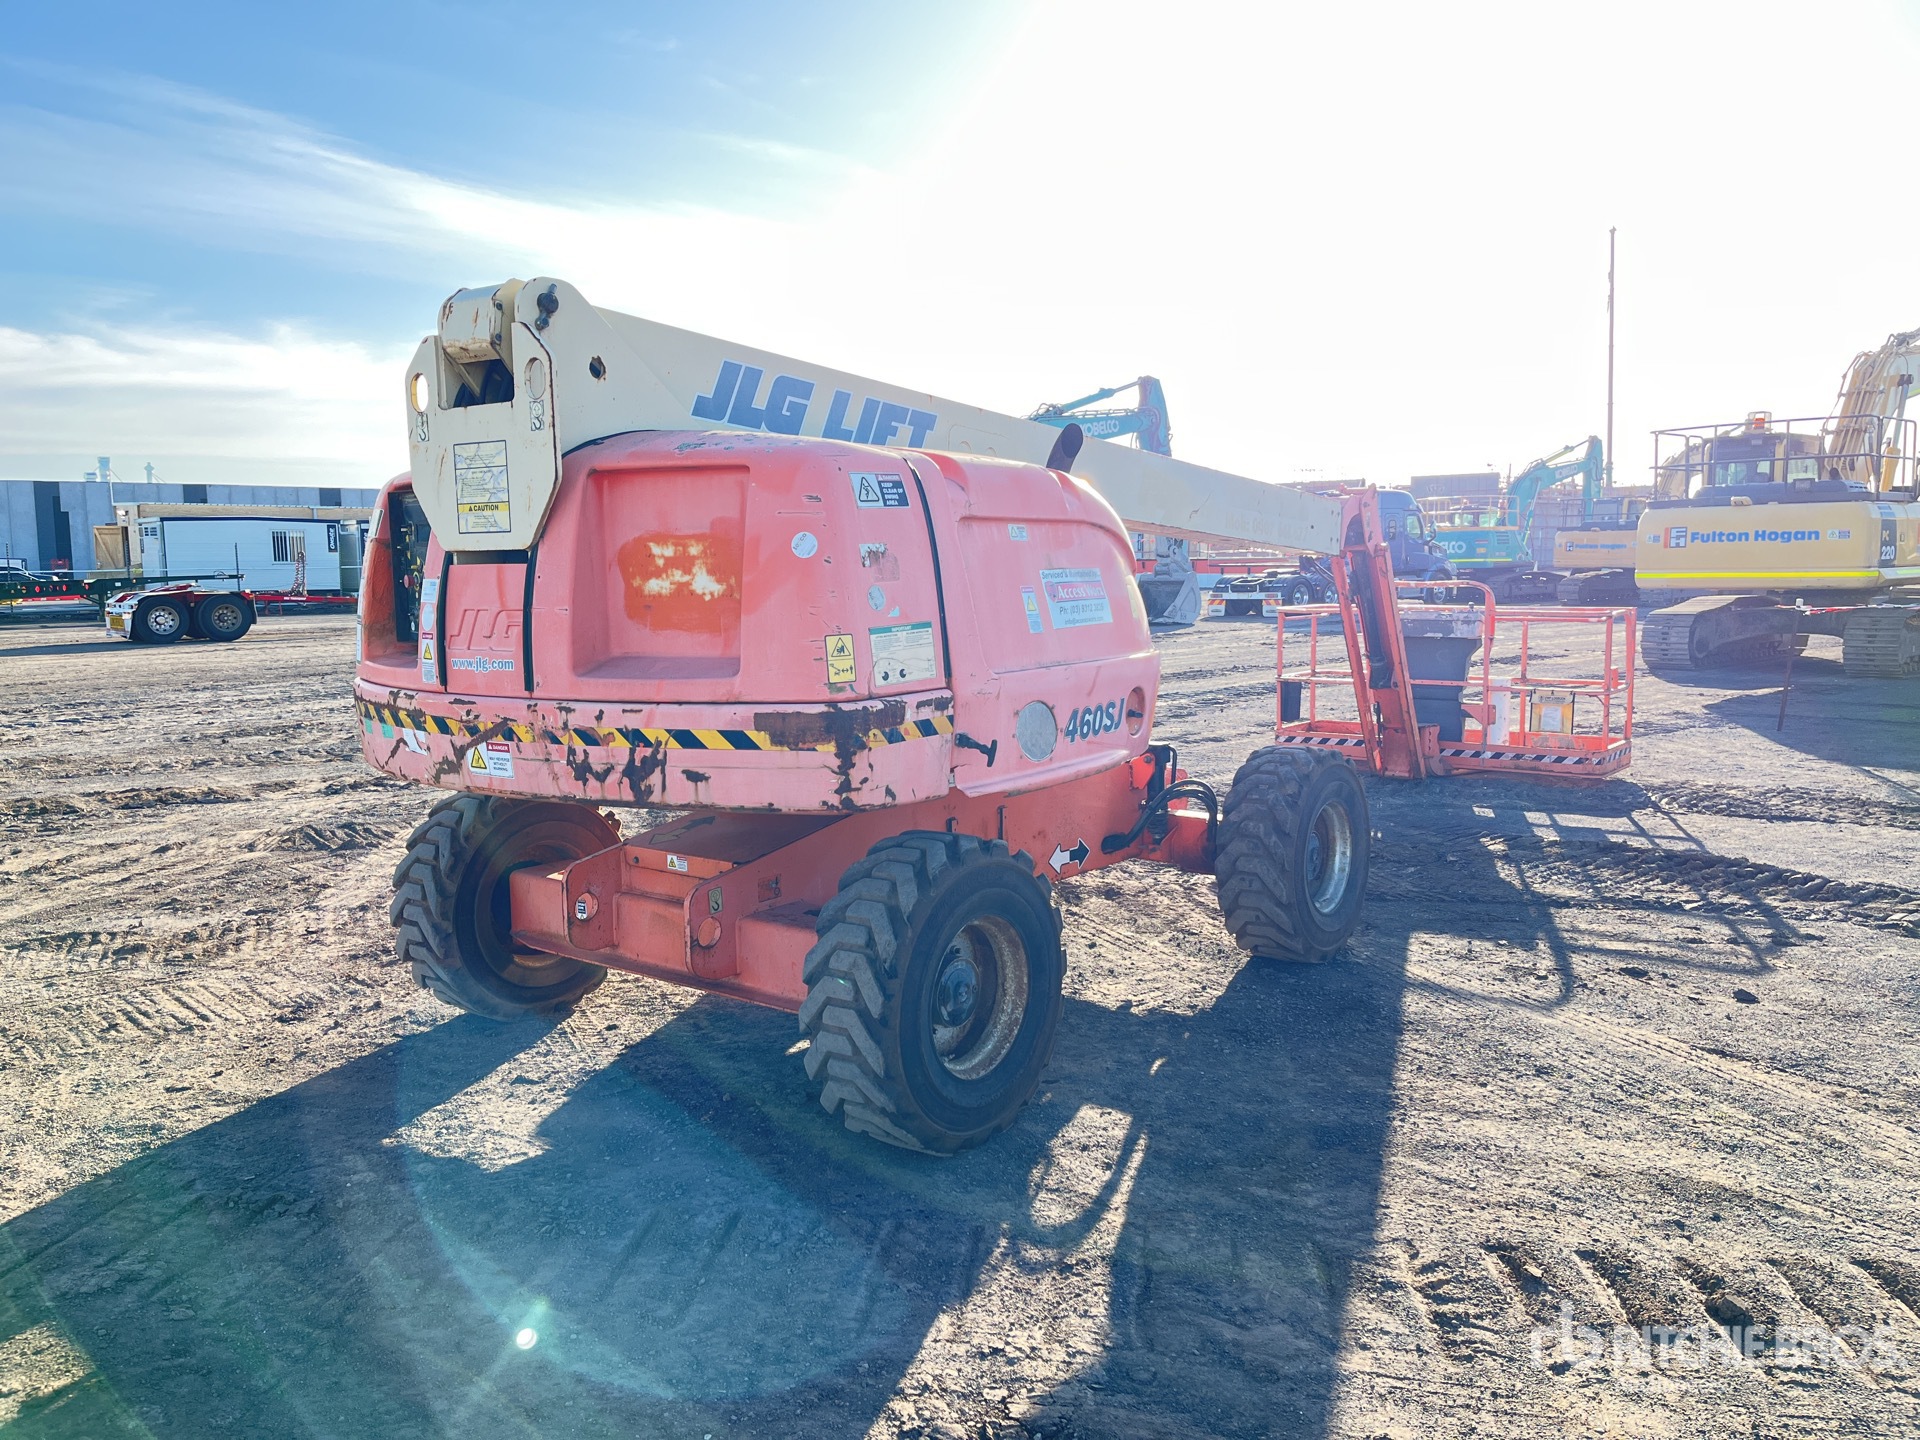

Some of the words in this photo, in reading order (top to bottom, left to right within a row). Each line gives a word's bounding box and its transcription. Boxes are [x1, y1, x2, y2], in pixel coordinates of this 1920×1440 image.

[691, 359, 816, 436] JLG
[820, 388, 938, 449] LIFT
[473, 504, 499, 512] CAUTION
[1690, 530, 1750, 544] Fulton
[1753, 529, 1820, 544] Hogan
[1881, 545, 1896, 560] 220
[1058, 584, 1086, 599] Access
[448, 608, 524, 652] JLG
[451, 656, 515, 673] www.jlg.com
[1064, 697, 1125, 744] 460SJ
